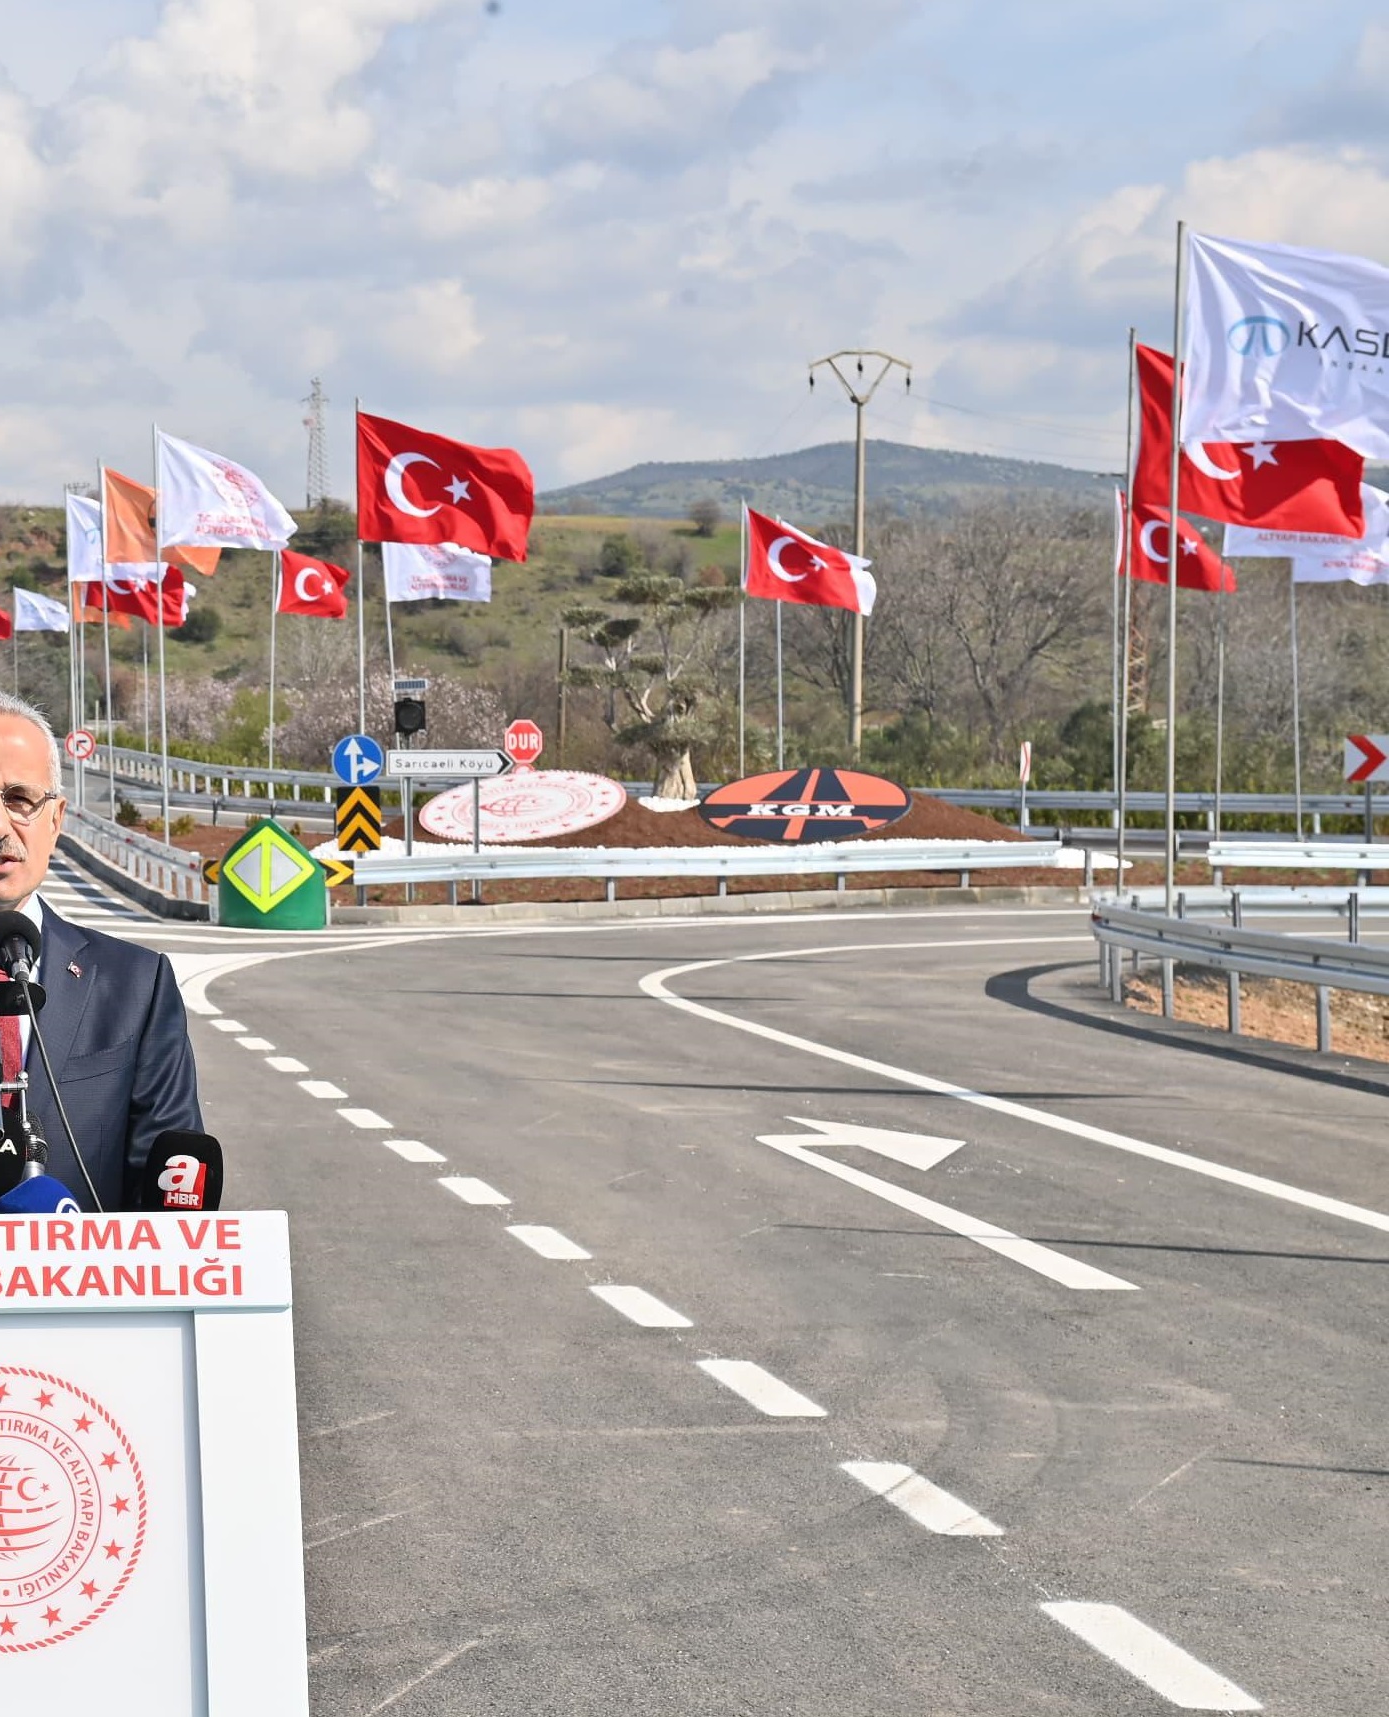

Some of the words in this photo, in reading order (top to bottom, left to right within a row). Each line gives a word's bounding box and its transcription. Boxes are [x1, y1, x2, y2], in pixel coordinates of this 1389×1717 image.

[508, 733, 540, 750] DUR
[460, 757, 494, 771] Köyü
[746, 803, 856, 817] KGM
[166, 1191, 200, 1206] HBR
[177, 1218, 242, 1250] VE
[51, 1437, 72, 1460] VE
[67, 1458, 95, 1527] ALTYAPI
[17, 1530, 91, 1599] BAKANLIĞI
